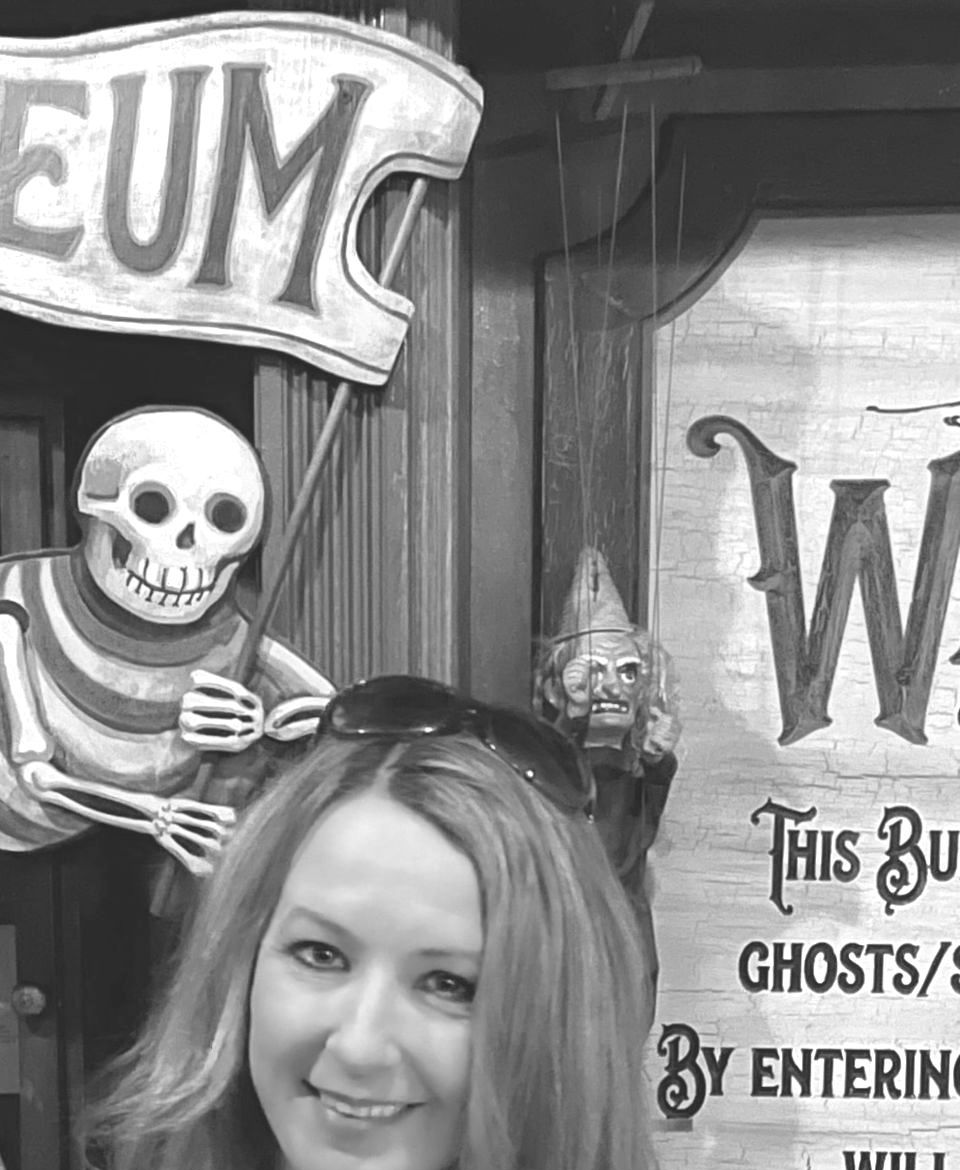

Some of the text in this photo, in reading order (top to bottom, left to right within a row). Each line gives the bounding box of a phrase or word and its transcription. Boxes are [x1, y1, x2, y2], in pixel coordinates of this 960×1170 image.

[751, 798, 860, 915] THIS
[657, 1023, 960, 1119] BY ENTERIN
